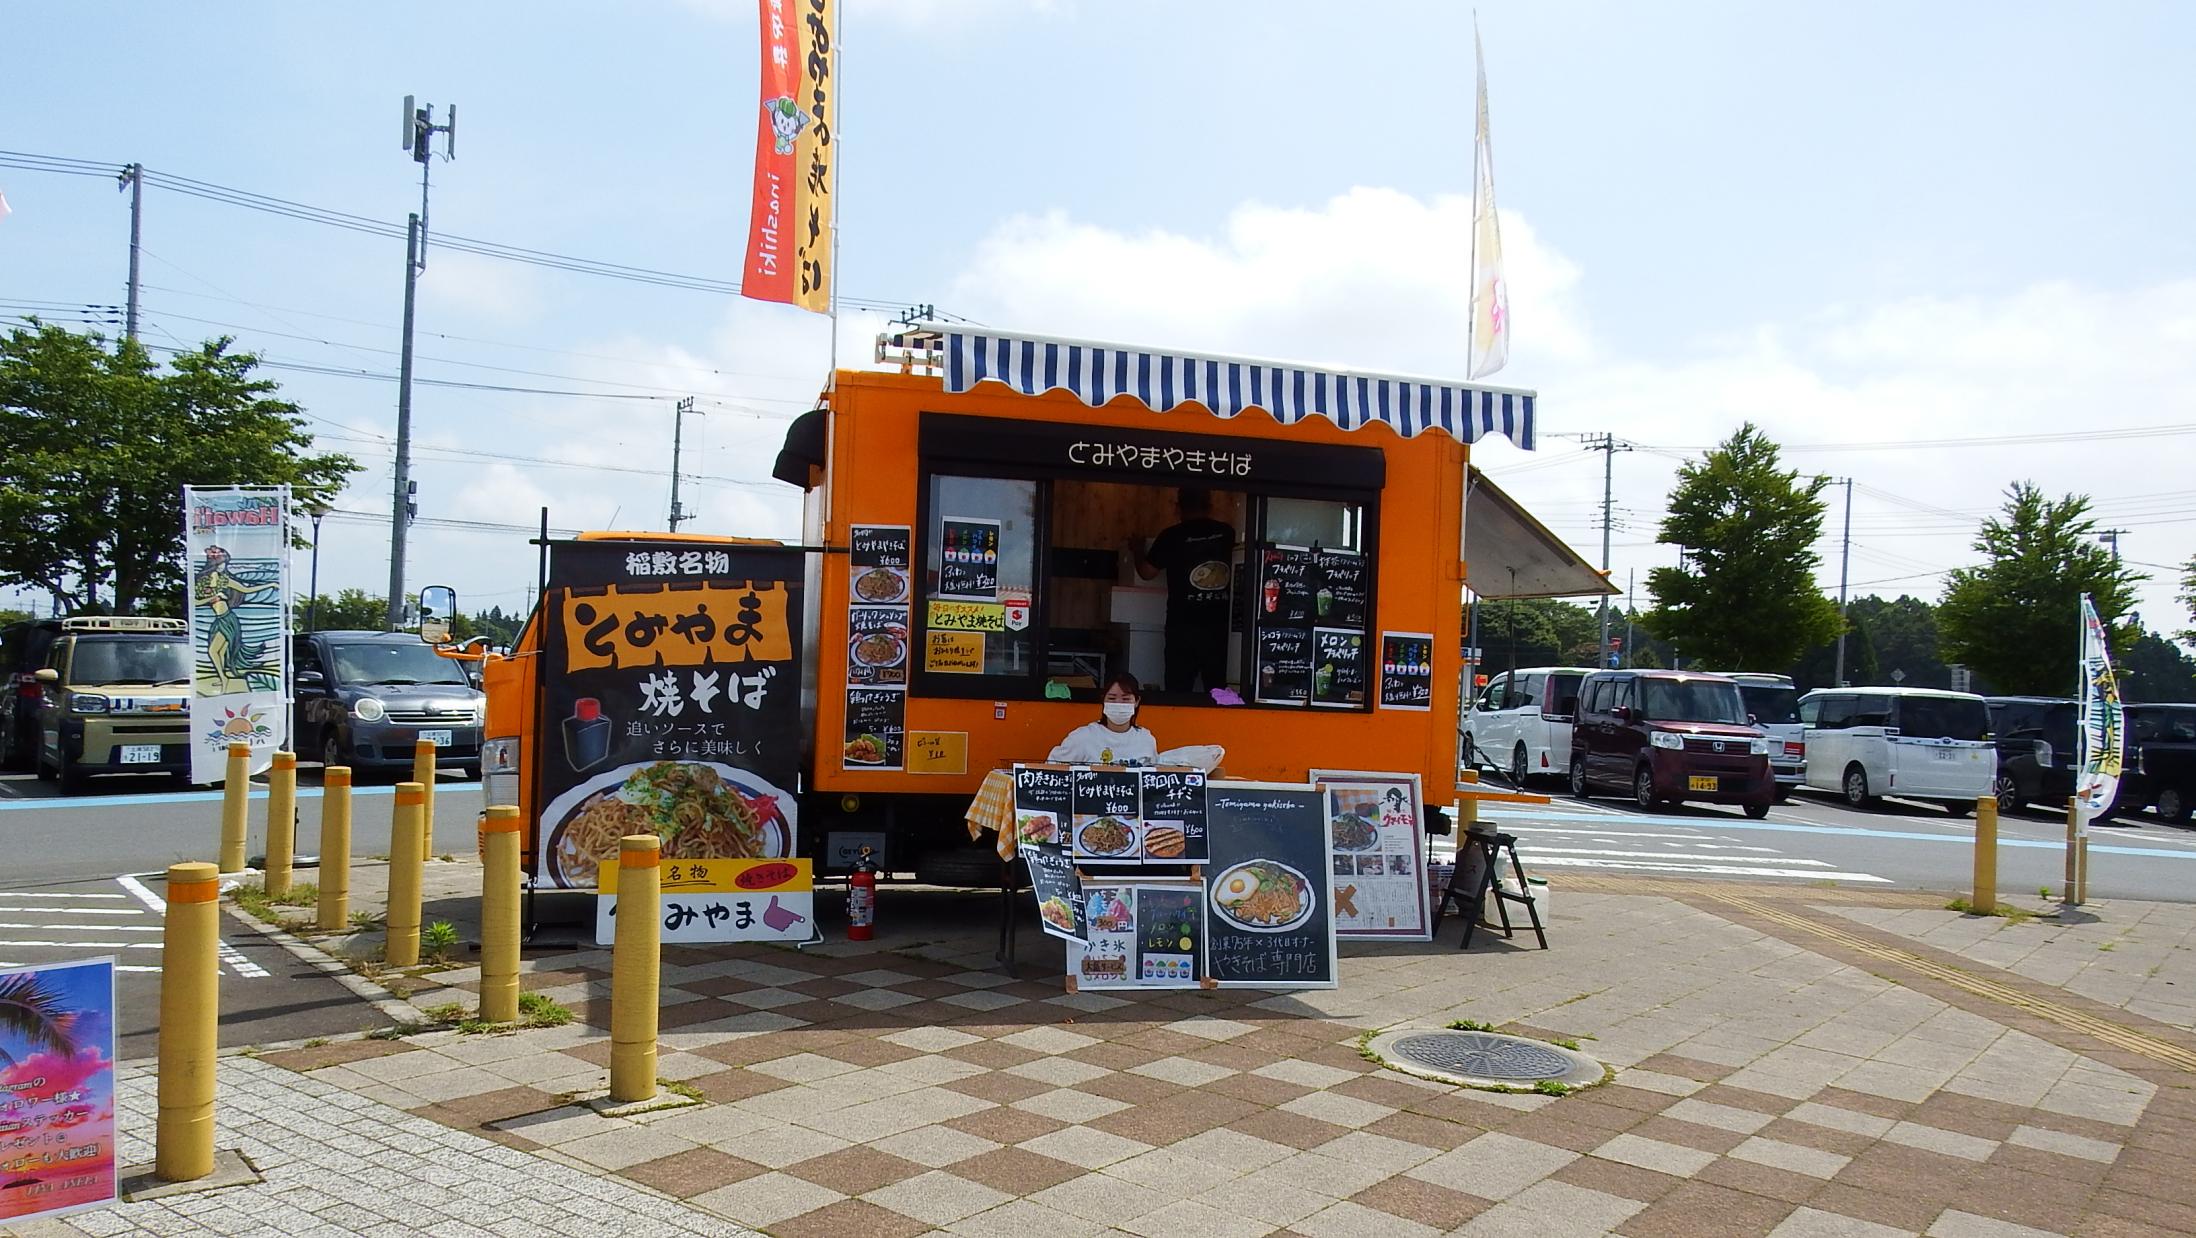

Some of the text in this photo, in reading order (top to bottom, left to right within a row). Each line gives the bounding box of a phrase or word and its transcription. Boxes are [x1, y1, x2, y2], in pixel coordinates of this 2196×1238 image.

[1068, 441, 1252, 476] とみやまやきそば
[626, 551, 730, 576] 稲敷名物
[575, 592, 764, 656] とみやま
[934, 612, 1004, 629] とみやま焼そば
[1320, 633, 1348, 647] メロン
[638, 666, 777, 717] 焼そば
[626, 721, 726, 737] 追いソースで
[653, 740, 762, 756] さらに美味しく
[129, 752, 160, 762] 21-19
[1143, 773, 1180, 789] 韓国風
[1079, 784, 1135, 798] とみやまやきそば
[1166, 785, 1192, 800] チヂミ
[1105, 802, 1129, 813] ¥600
[1185, 824, 1203, 834] ¥600
[661, 863, 710, 883] 名物
[1148, 937, 1173, 949] レモン
